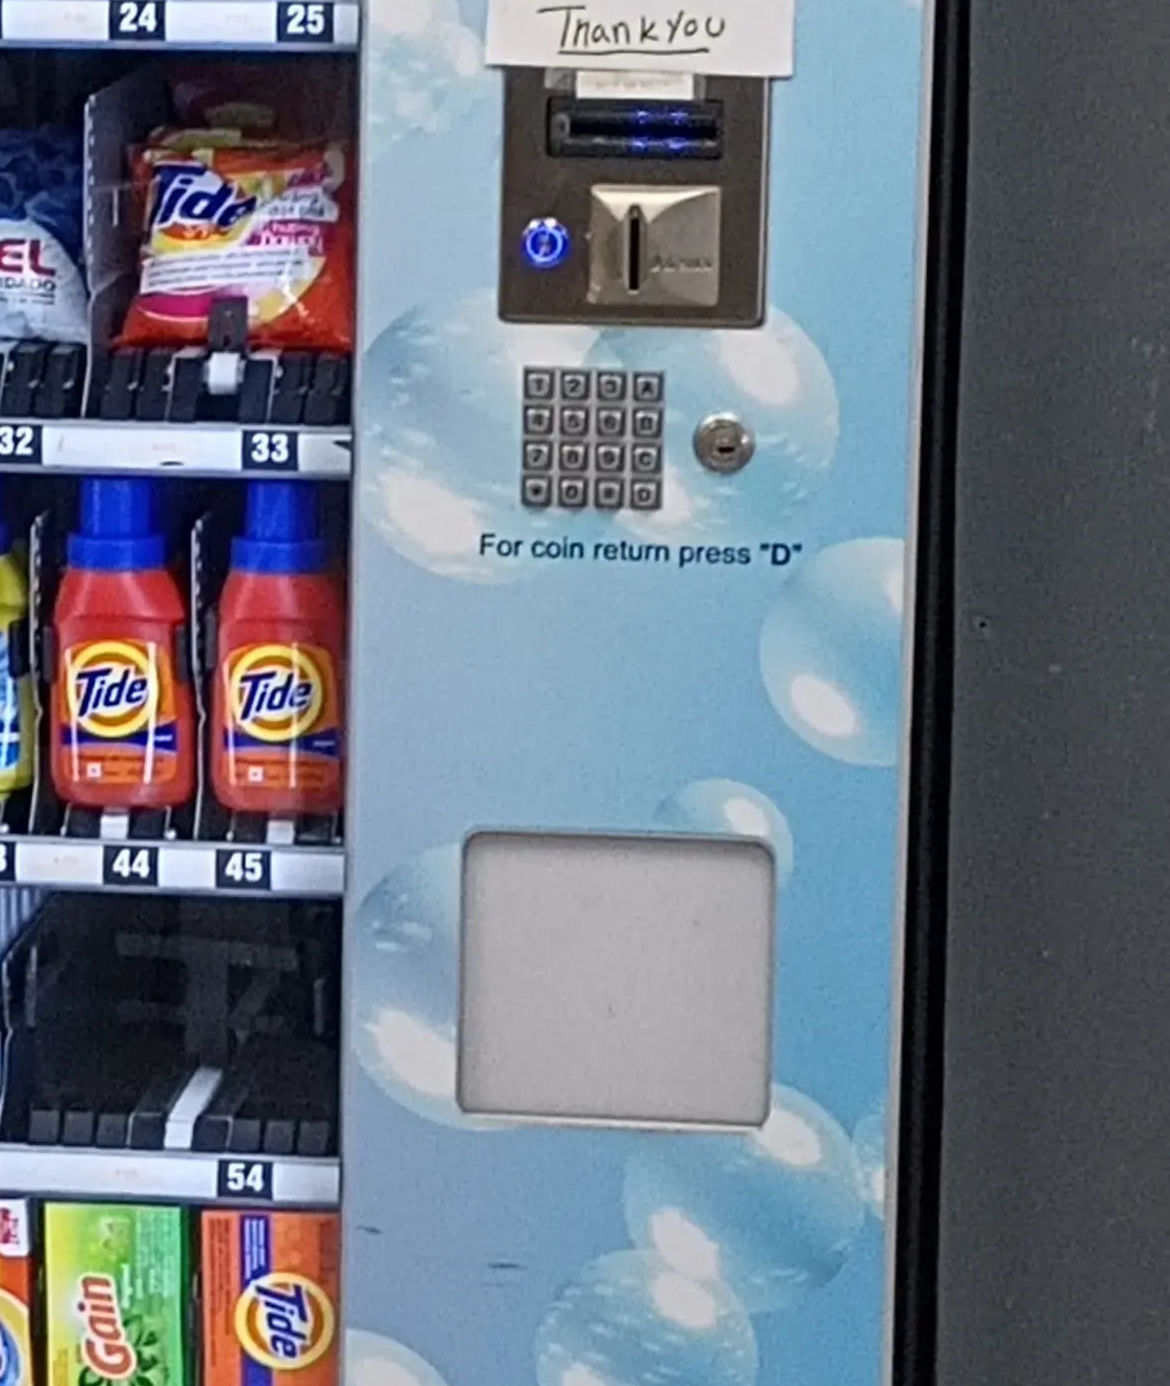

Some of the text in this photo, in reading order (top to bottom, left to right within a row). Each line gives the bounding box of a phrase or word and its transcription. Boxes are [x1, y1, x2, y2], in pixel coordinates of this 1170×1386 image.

[119, 4, 156, 31] 24
[287, 6, 325, 34] 25
[251, 433, 289, 462] 33
[480, 533, 803, 568] For coin return press "D"
[76, 667, 149, 717] Tide
[239, 668, 312, 721] Tide
[112, 849, 149, 877] 44
[225, 852, 262, 881] 45
[228, 1165, 264, 1191] 54
[77, 1275, 133, 1376] Gain
[256, 1283, 308, 1359] Tide
